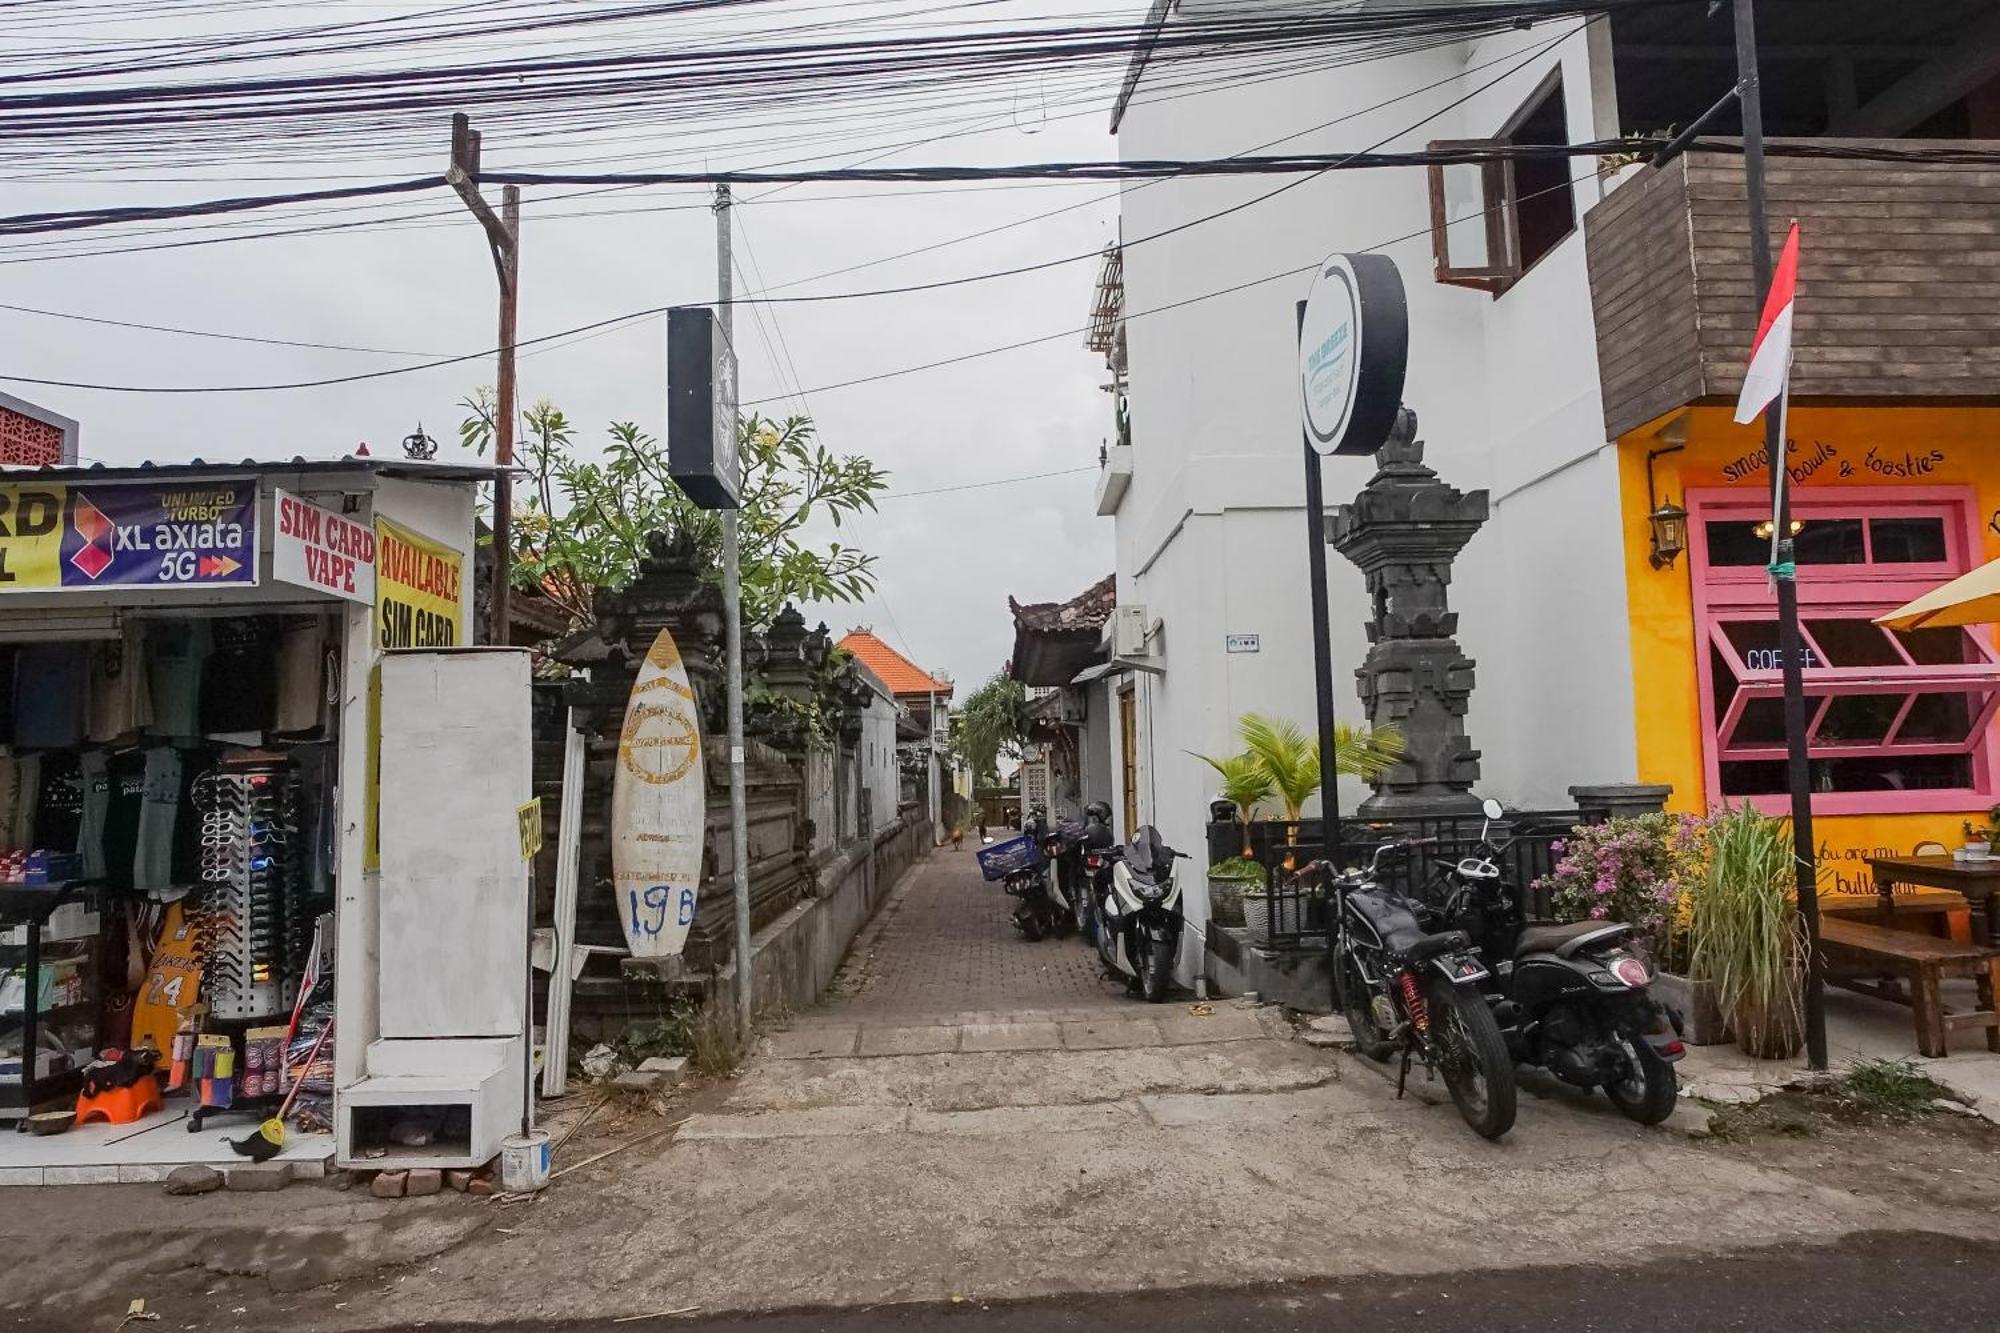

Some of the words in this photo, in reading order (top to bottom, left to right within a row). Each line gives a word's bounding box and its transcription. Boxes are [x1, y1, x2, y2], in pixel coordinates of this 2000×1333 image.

[1785, 439, 1837, 486] bowls
[1864, 446, 1944, 477] toasties
[0, 491, 59, 537] D
[161, 490, 236, 508] UNLIMITED
[170, 506, 220, 521] TURBO
[115, 525, 150, 551] XL
[155, 514, 243, 551] axiata
[280, 497, 321, 545] SIM
[325, 515, 376, 565] CARD
[158, 551, 197, 582] 5G
[304, 544, 356, 594] VAPE
[381, 535, 460, 604] AVAILABLE
[381, 597, 413, 649] SIM
[415, 607, 455, 647] CARD
[1844, 847, 1869, 861] are
[630, 885, 671, 936] 19
